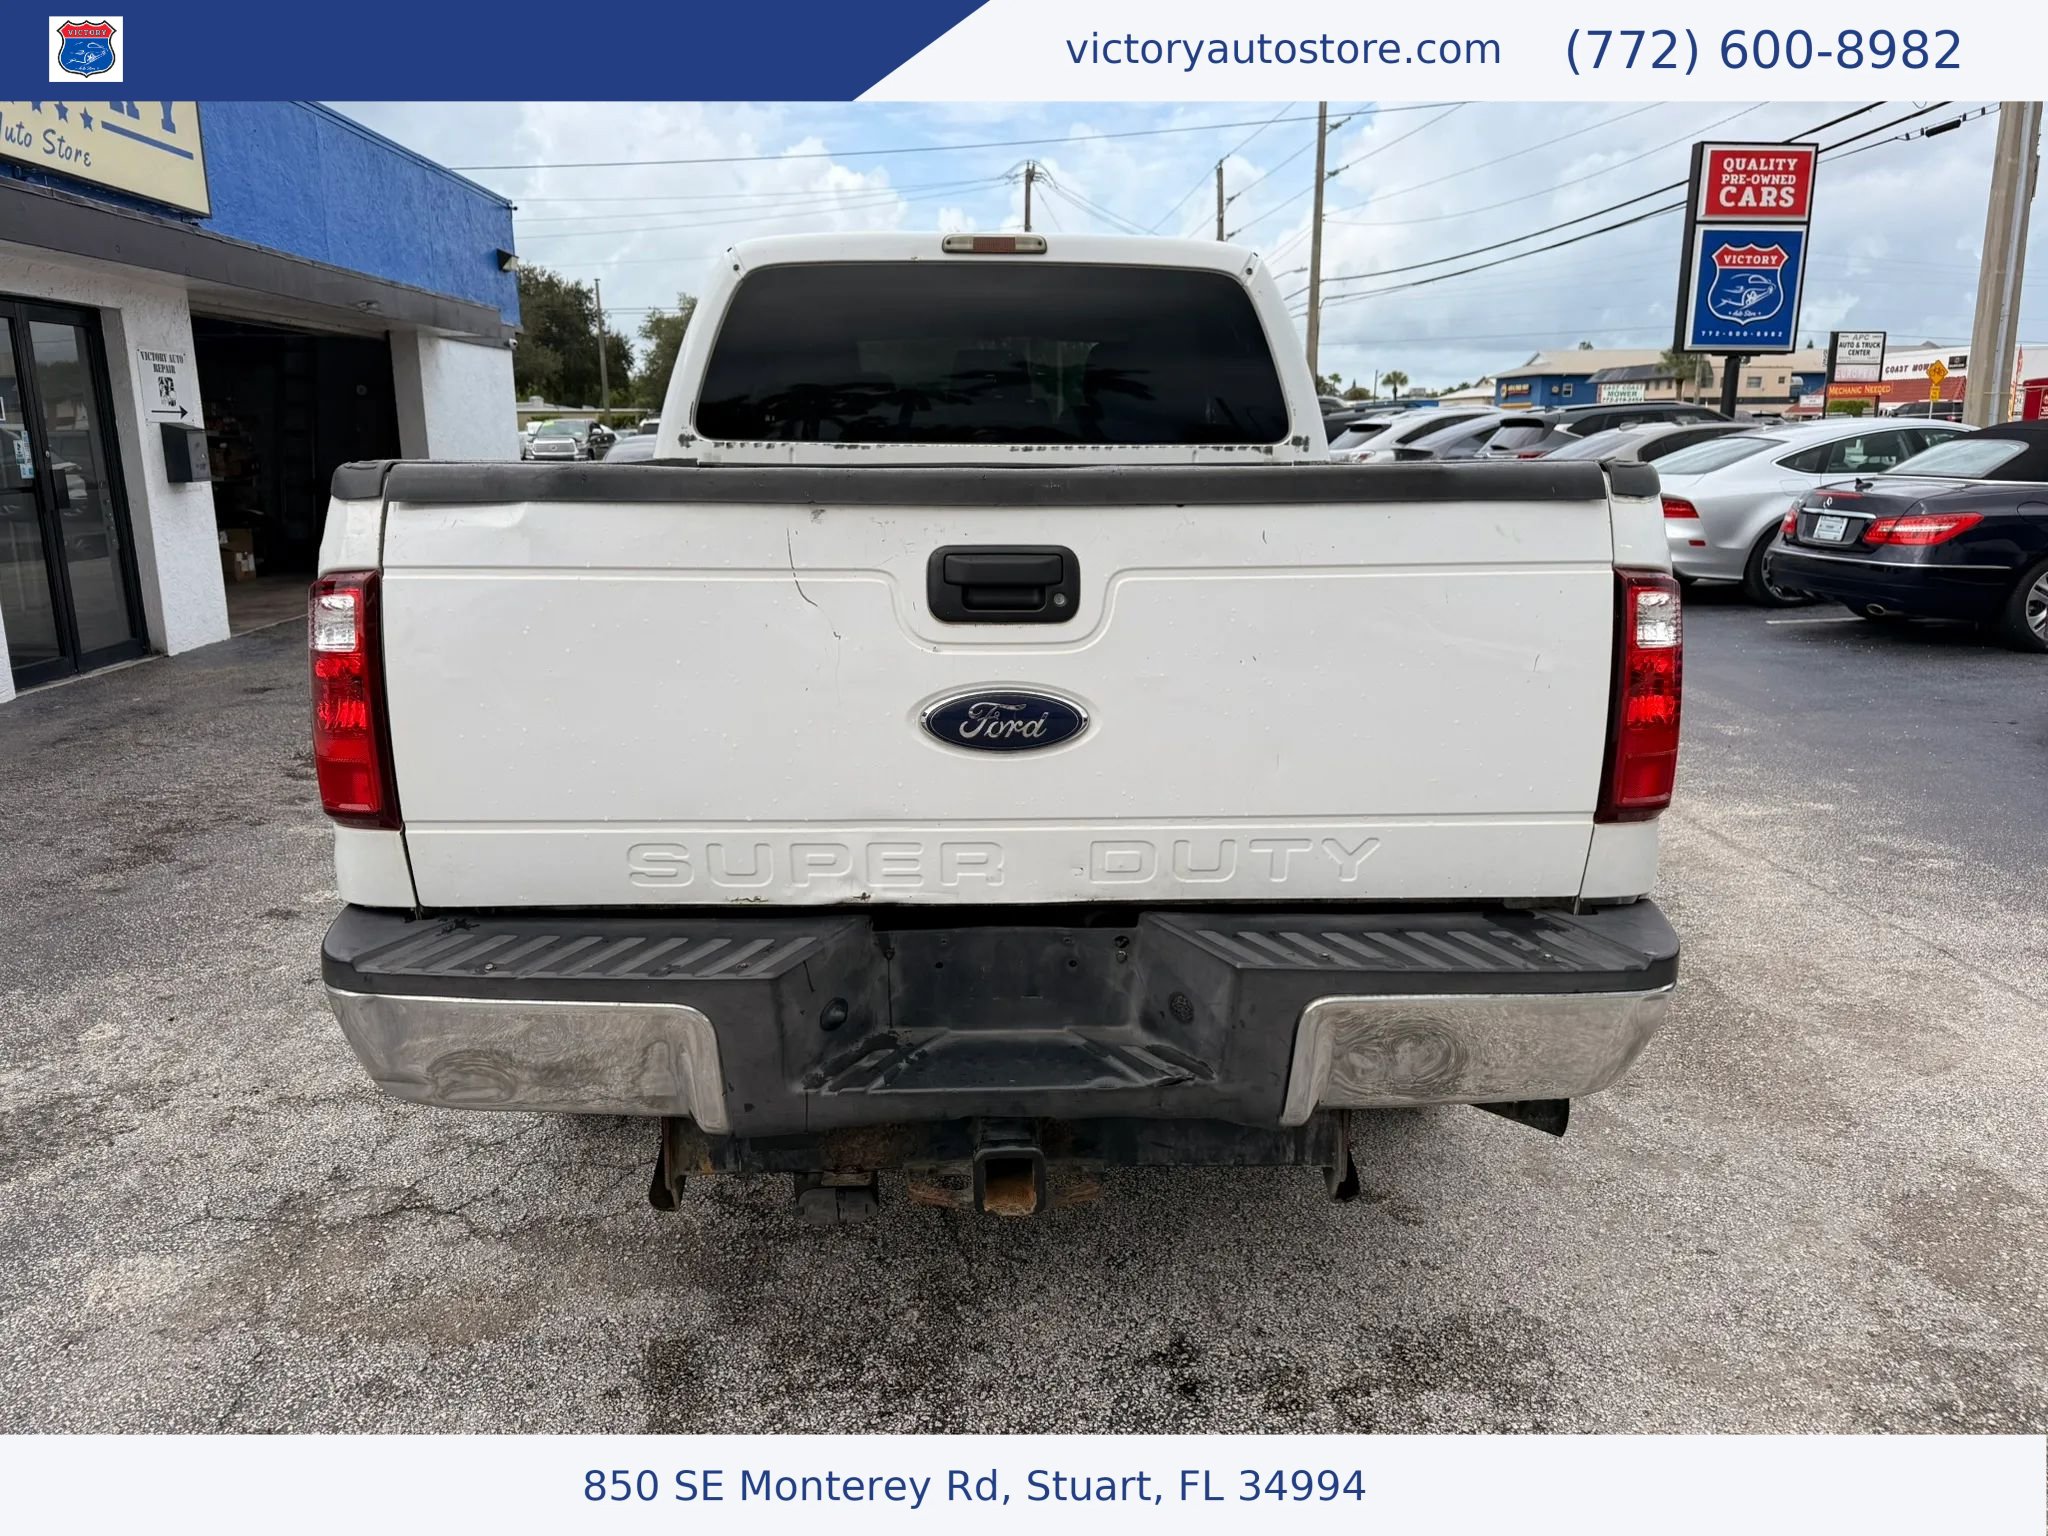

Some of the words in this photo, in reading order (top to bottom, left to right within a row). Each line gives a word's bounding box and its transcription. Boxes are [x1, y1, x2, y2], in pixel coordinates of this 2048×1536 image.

[0, 111, 33, 148] uto
[42, 128, 92, 167] Store
[1723, 157, 1798, 171] QUALITY
[1721, 174, 1796, 185] PRE-OWNED
[1719, 186, 1795, 208] CARS
[1724, 255, 1778, 265] VICTORY
[153, 363, 176, 374] REPAIR
[1885, 365, 1908, 374] COAST
[959, 702, 1049, 738] Ford
[626, 842, 1006, 888] SUPER
[1089, 837, 1382, 885] DUTY
